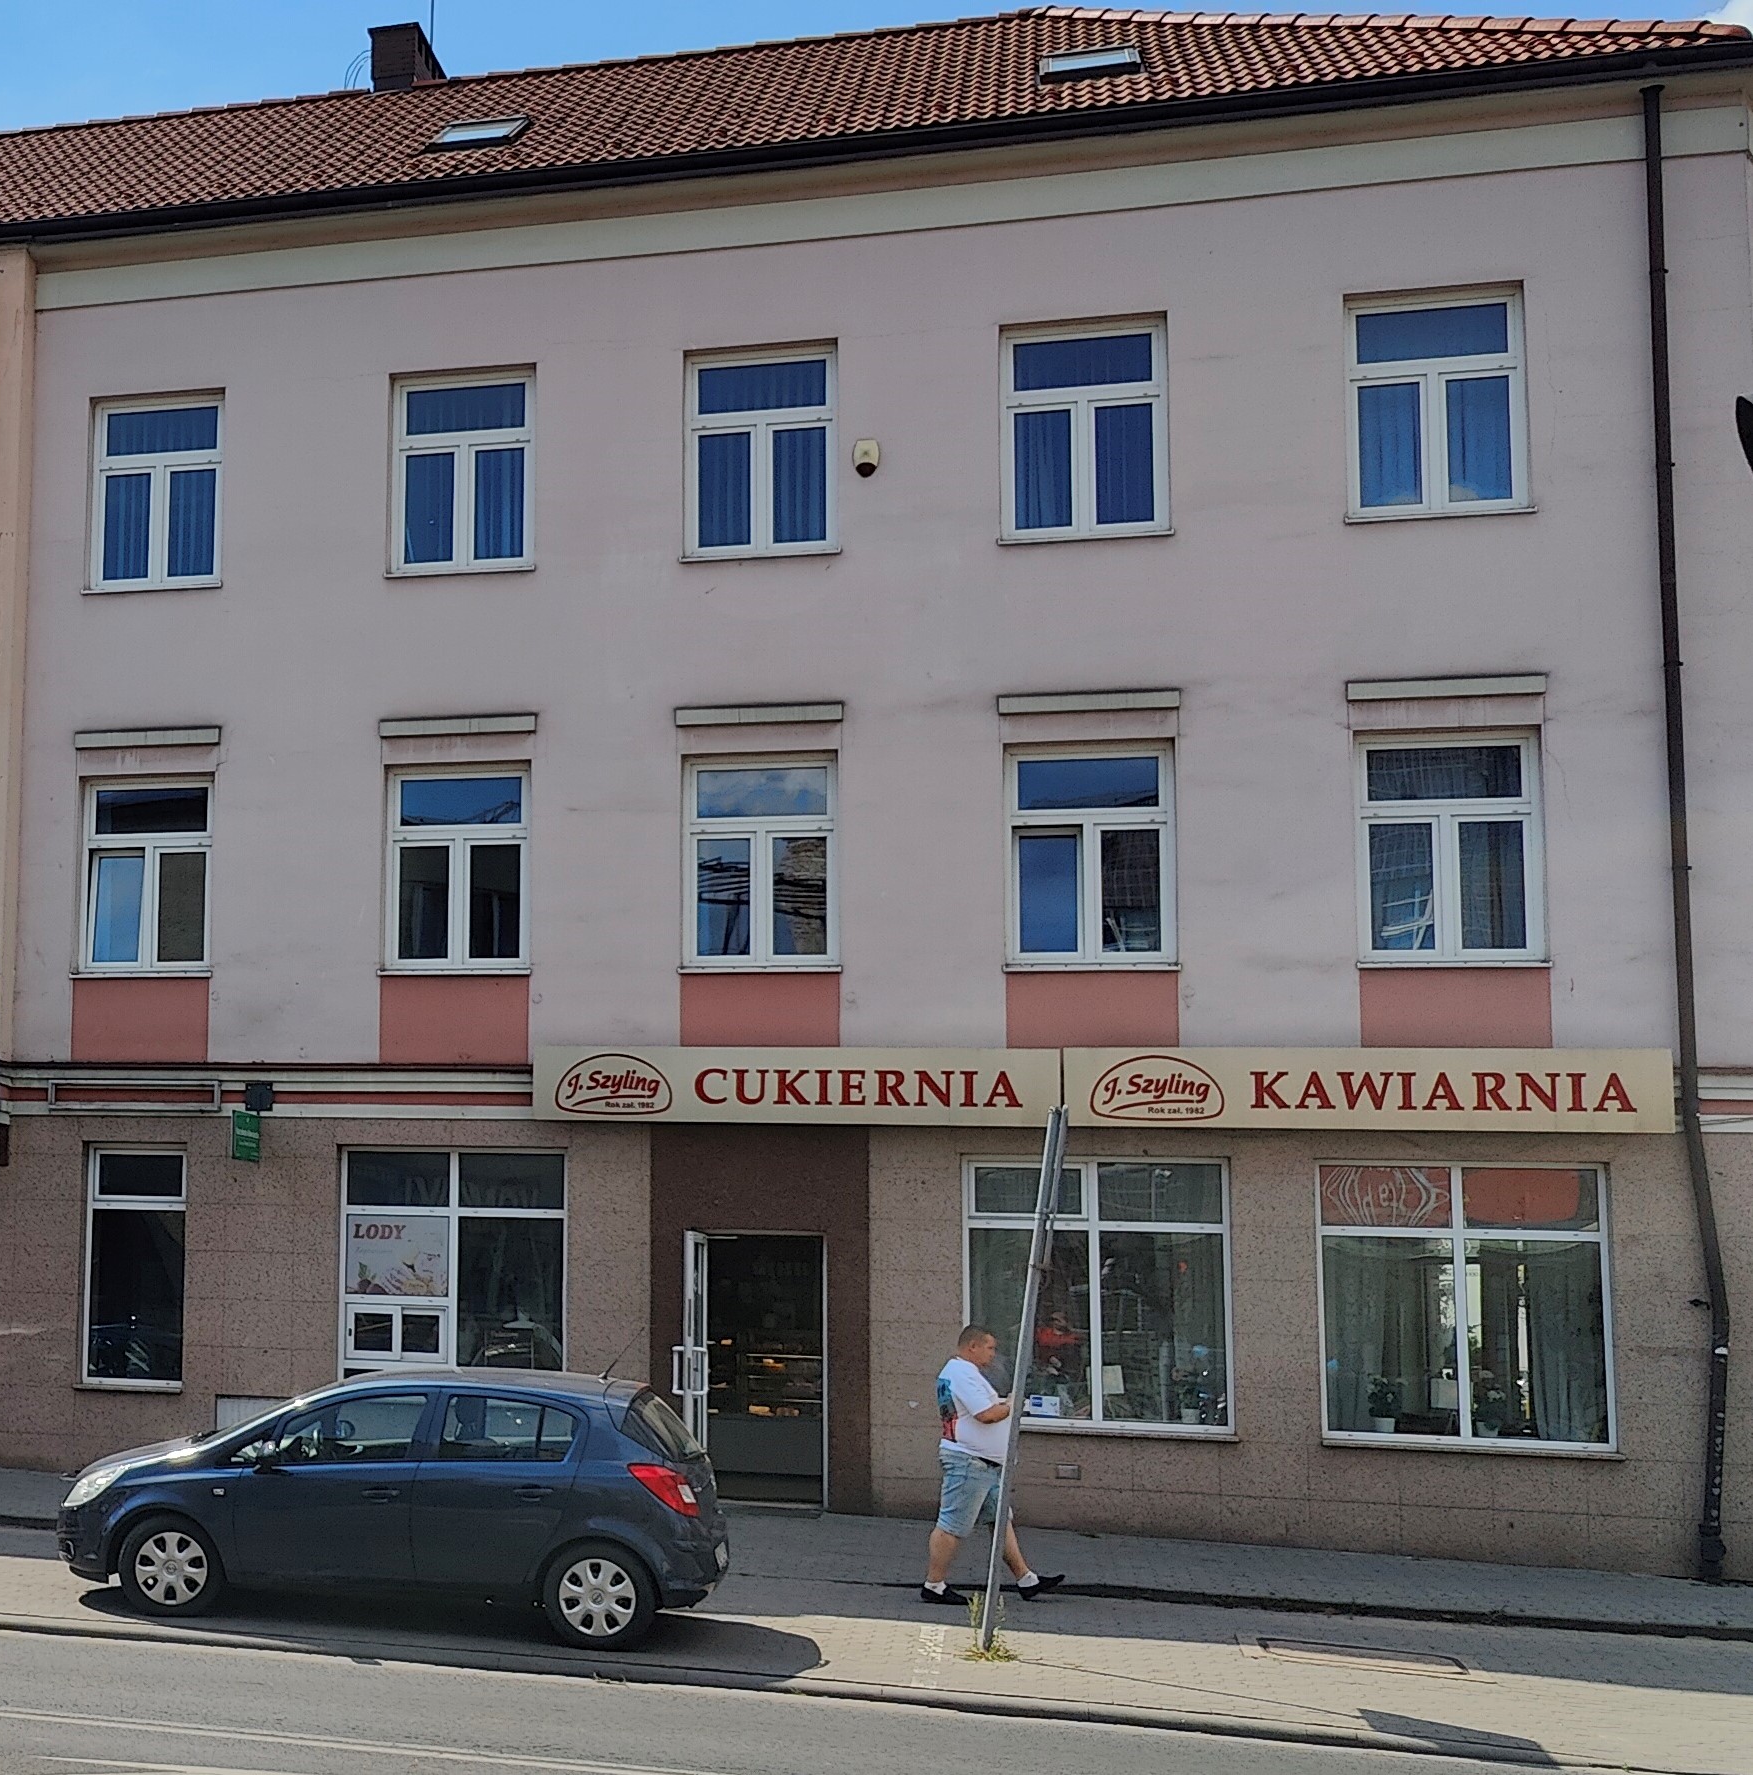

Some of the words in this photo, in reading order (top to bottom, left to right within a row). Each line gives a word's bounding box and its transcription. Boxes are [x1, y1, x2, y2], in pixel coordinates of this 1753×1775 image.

[588, 1070, 661, 1098] Szyling
[693, 1067, 1024, 1108] CUKIERNIA
[1127, 1068, 1211, 1103] Szyling
[1250, 1070, 1638, 1113] KAWIARNIA
[604, 1100, 621, 1108] Rok
[638, 1101, 656, 1109] 1982
[1147, 1106, 1166, 1115] Rok
[1185, 1106, 1205, 1115] 1982
[353, 1223, 407, 1240] LODY
